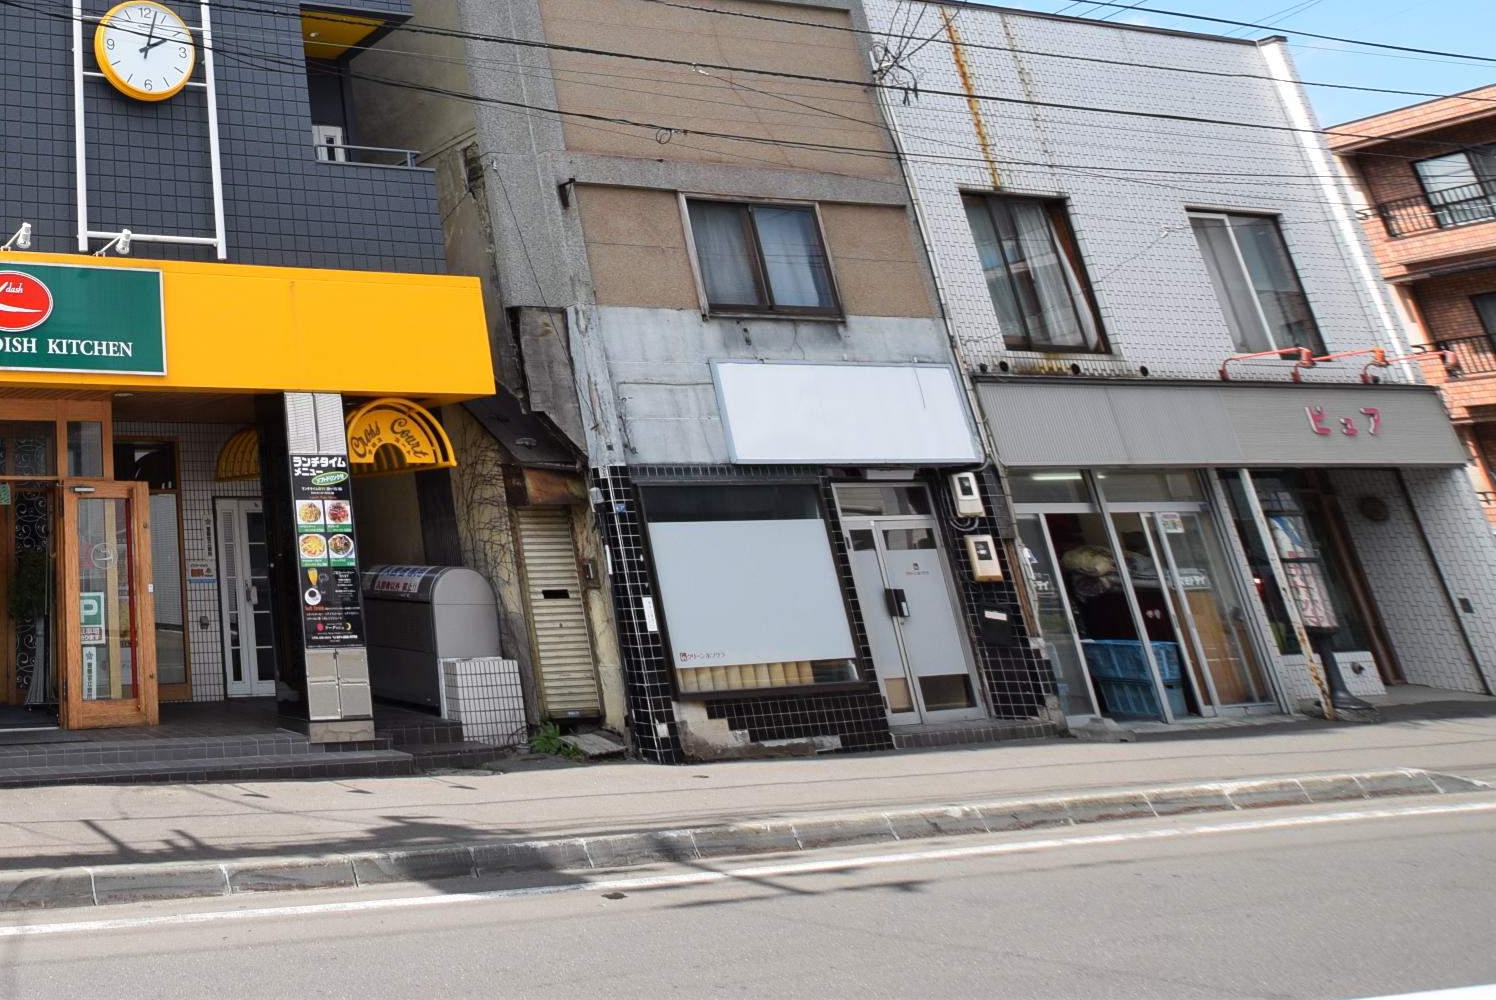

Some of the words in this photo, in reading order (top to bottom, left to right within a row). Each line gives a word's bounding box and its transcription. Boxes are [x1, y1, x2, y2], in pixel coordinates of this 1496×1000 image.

[138, 7, 152, 18] 12
[106, 38, 115, 50] 9
[178, 46, 187, 59] 3
[144, 78, 152, 91] 6
[5, 282, 24, 294] dash
[47, 338, 133, 357] KITCHEN
[351, 420, 381, 458] Cross
[390, 418, 429, 458] Court
[292, 456, 346, 468] ランチタイム
[294, 467, 323, 476] メニュー
[81, 599, 98, 624] P
